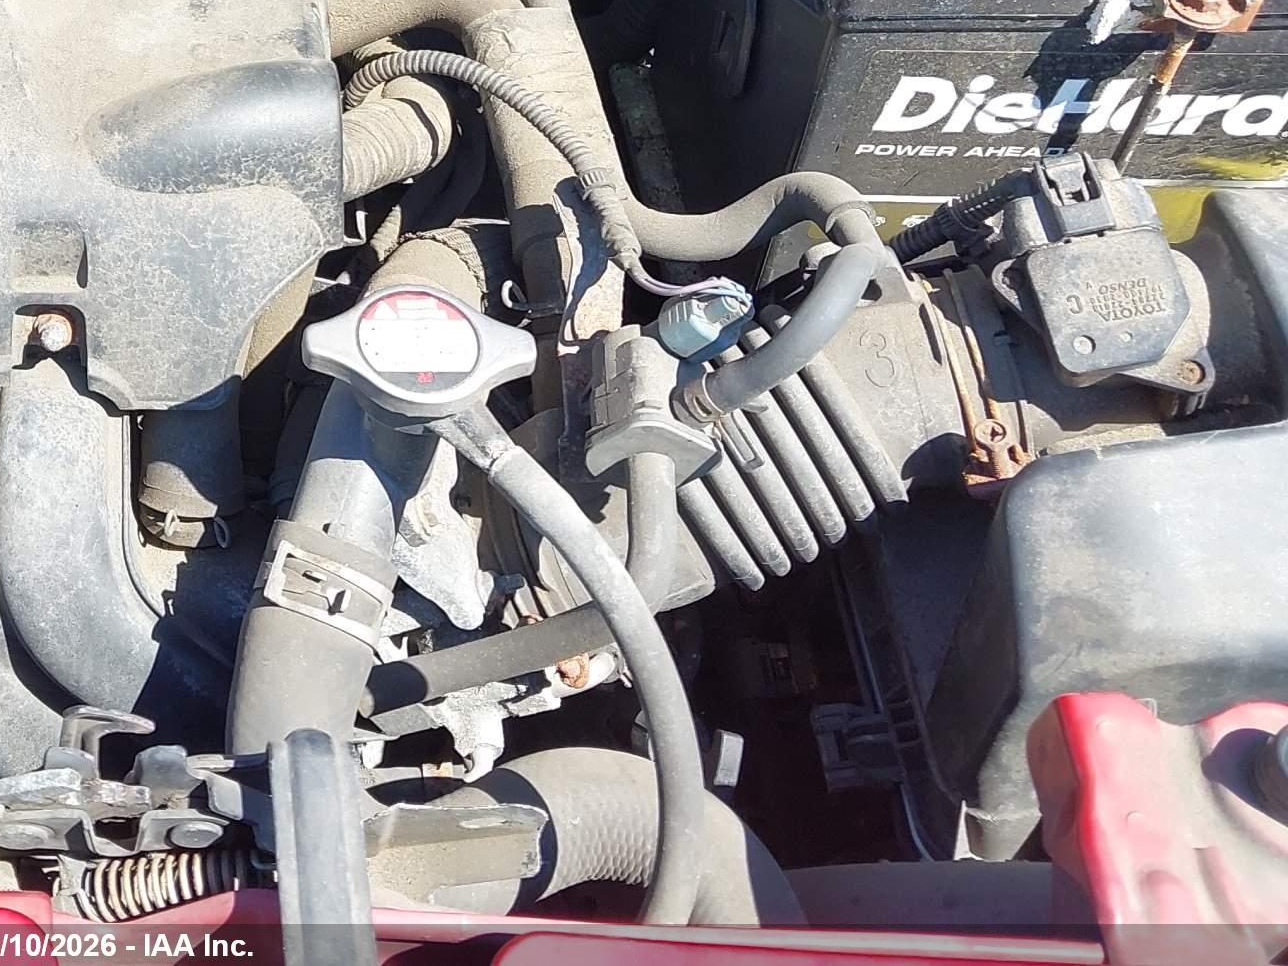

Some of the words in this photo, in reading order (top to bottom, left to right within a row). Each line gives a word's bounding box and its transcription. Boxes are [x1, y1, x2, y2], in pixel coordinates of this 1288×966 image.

[871, 74, 1288, 136] DieHard
[854, 144, 958, 157] POWER
[962, 146, 1066, 158] AHEAD
[1098, 277, 1147, 295] DENSO
[1097, 301, 1167, 322] TOYOTA
